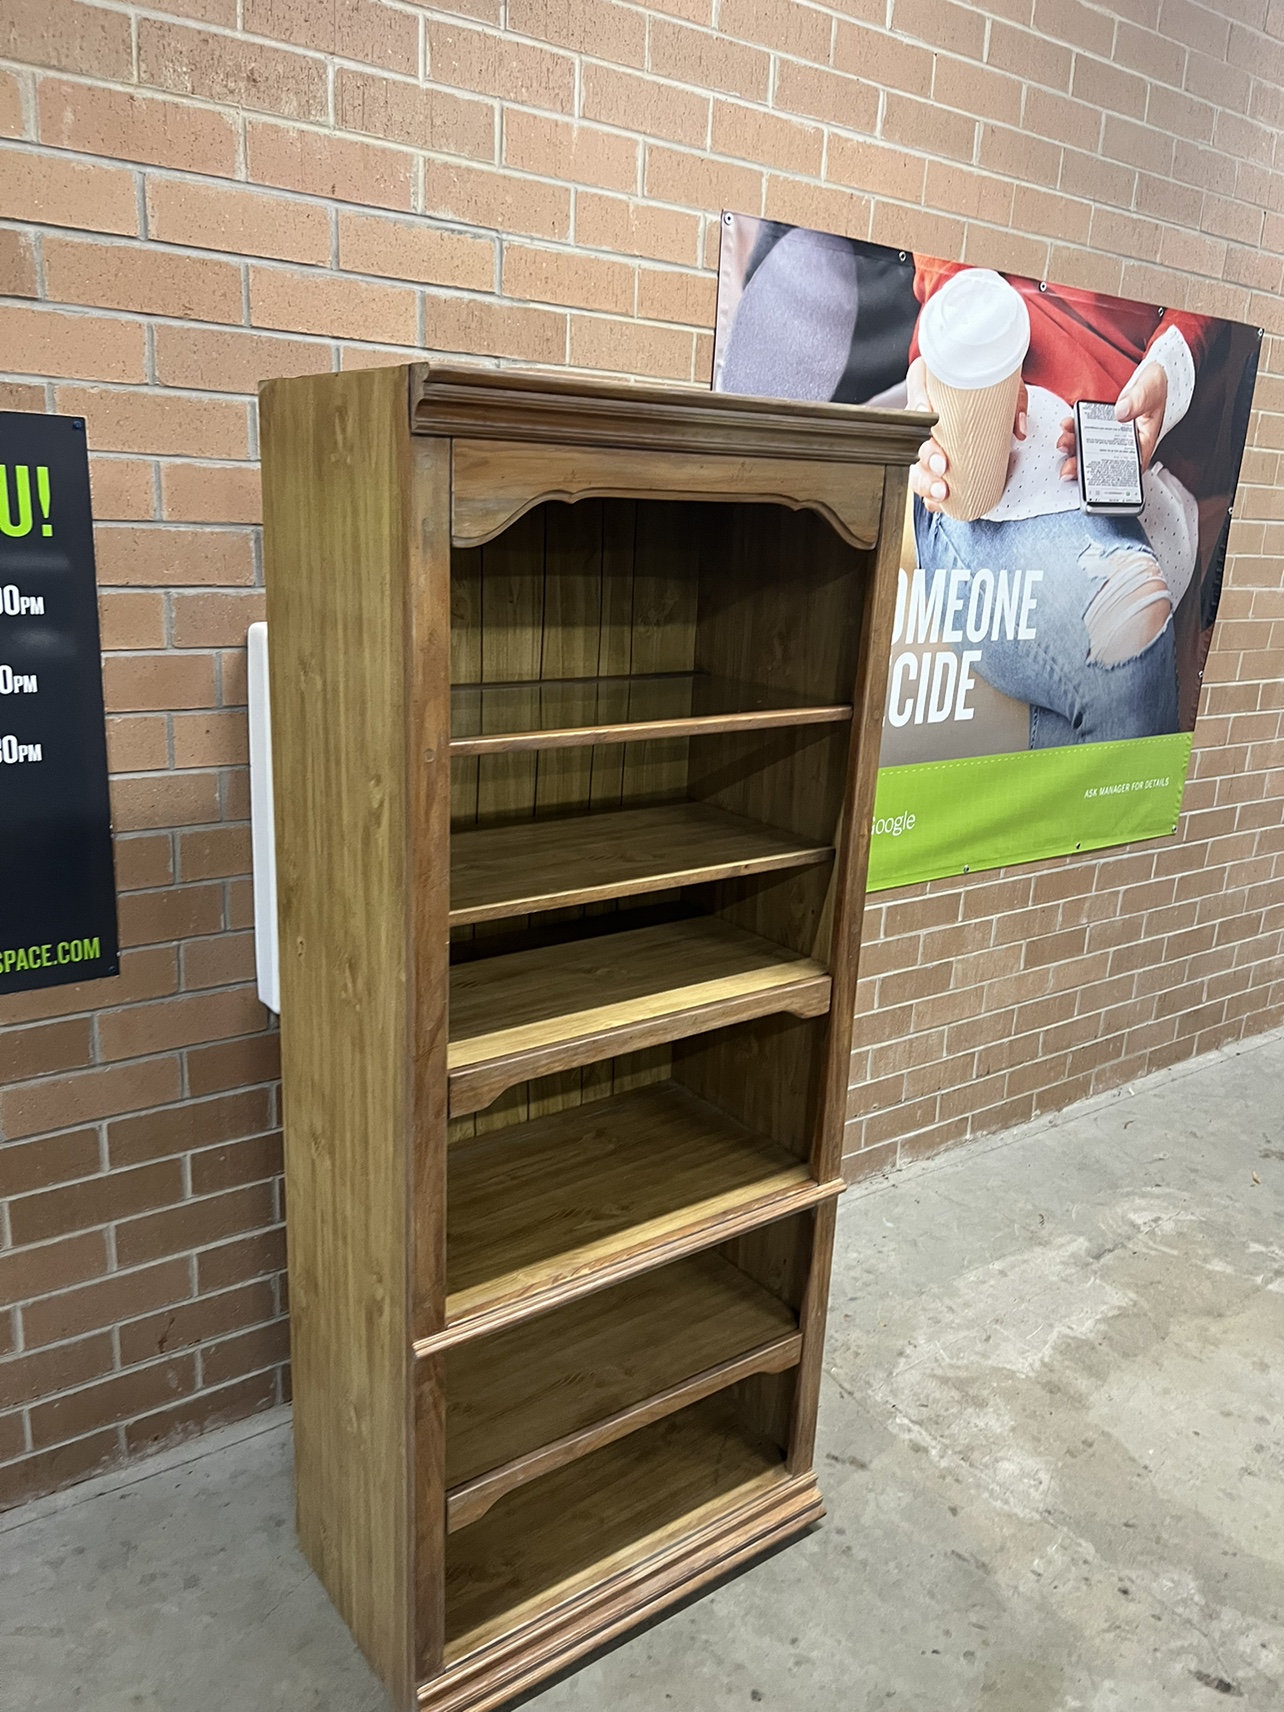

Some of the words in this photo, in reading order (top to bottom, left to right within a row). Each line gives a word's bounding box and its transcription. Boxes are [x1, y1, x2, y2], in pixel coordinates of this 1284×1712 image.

[0, 464, 53, 537] U!
[0, 584, 45, 616] 0PM
[883, 650, 982, 728] CIDE
[0, 734, 42, 764] 0PM
[1084, 788, 1098, 798] ASK
[1099, 783, 1130, 796] MANAGER
[1131, 781, 1143, 791] FOR
[1144, 777, 1169, 789] DETAILS
